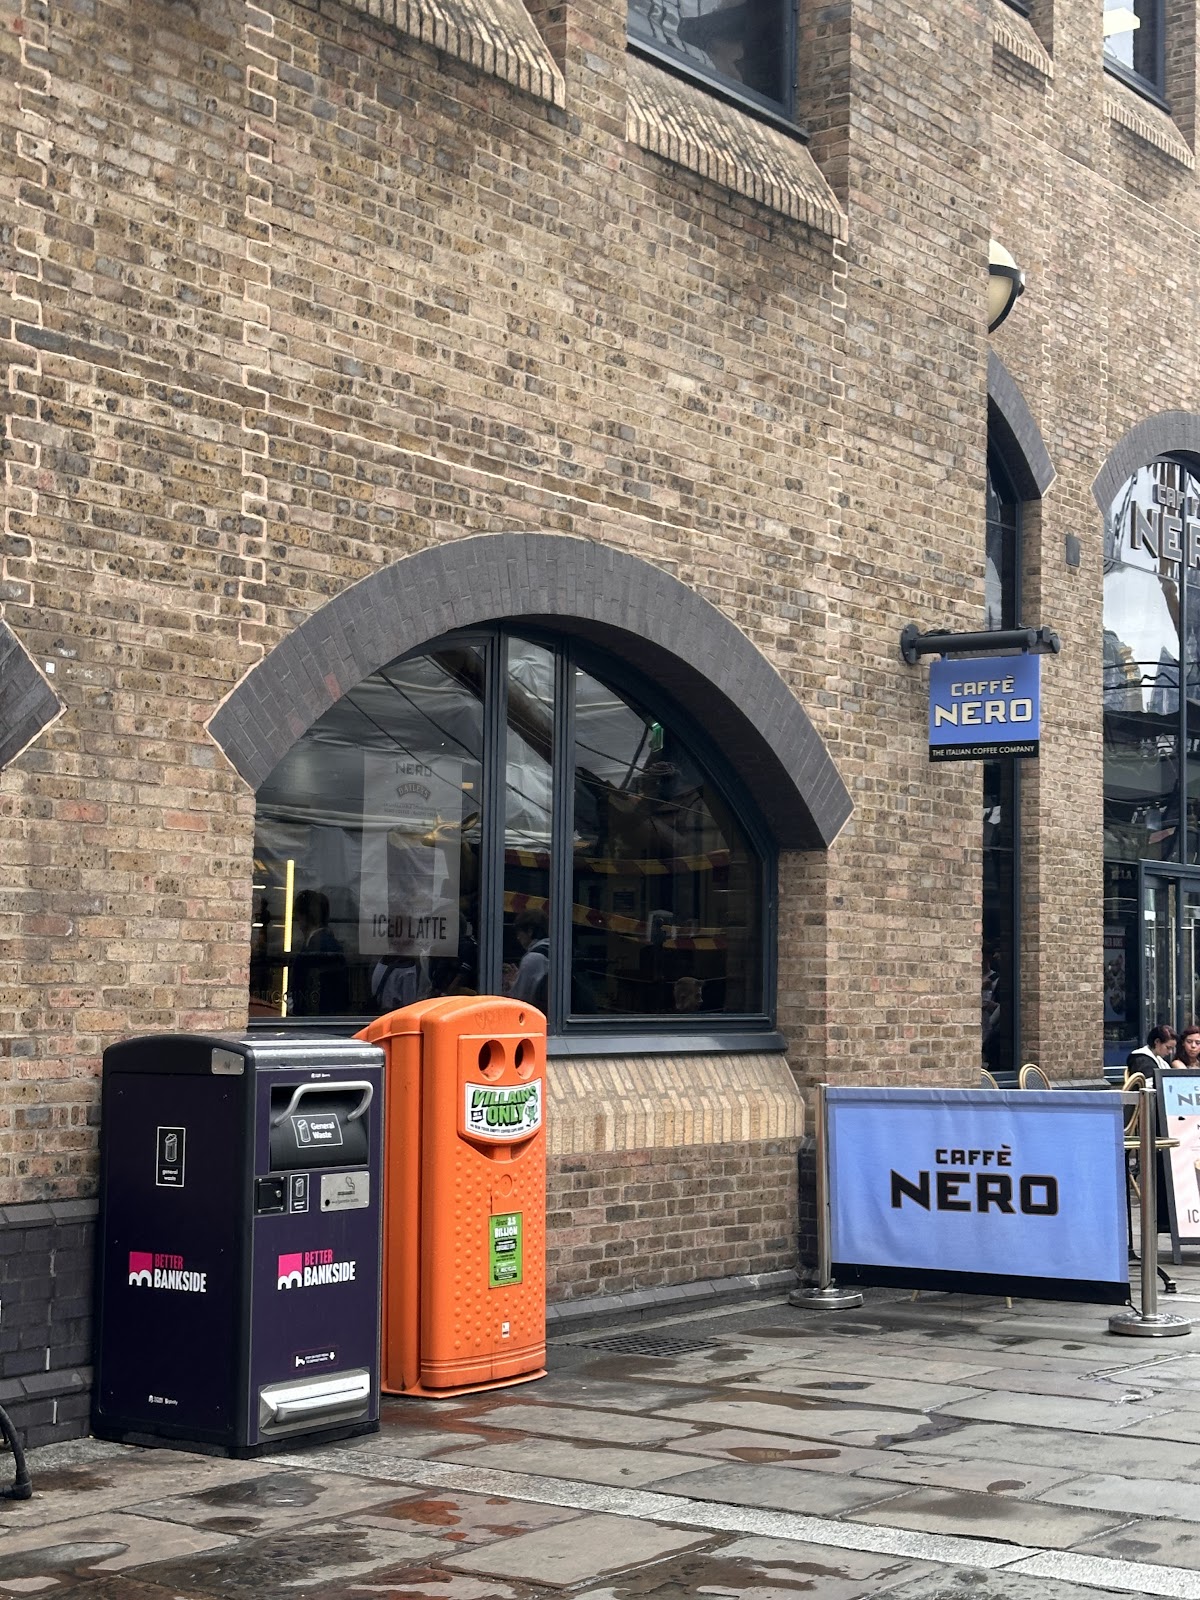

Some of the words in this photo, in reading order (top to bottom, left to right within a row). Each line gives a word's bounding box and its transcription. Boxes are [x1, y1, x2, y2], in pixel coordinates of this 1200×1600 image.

[951, 674, 1014, 697] CAFFÈ
[934, 698, 1032, 727] NERO
[946, 748, 971, 756] ITALIAN
[972, 747, 998, 755] COFFEE
[999, 745, 1035, 754] COMPANY
[372, 914, 403, 938] ICED
[408, 915, 447, 940] LATTE
[472, 1085, 539, 1109] VILLAINS
[310, 1121, 336, 1131] General
[486, 1104, 526, 1127] ONLY
[312, 1131, 333, 1139] Waste
[935, 1144, 1012, 1167] CAFFÈ
[162, 1168, 179, 1176] general
[890, 1168, 1059, 1217] NERO
[494, 1226, 518, 1239] BILLION
[155, 1253, 184, 1270] BETTER
[305, 1249, 333, 1266] BETTER
[154, 1268, 207, 1293] BANKSIDE
[304, 1261, 356, 1287] BANKSIDE
